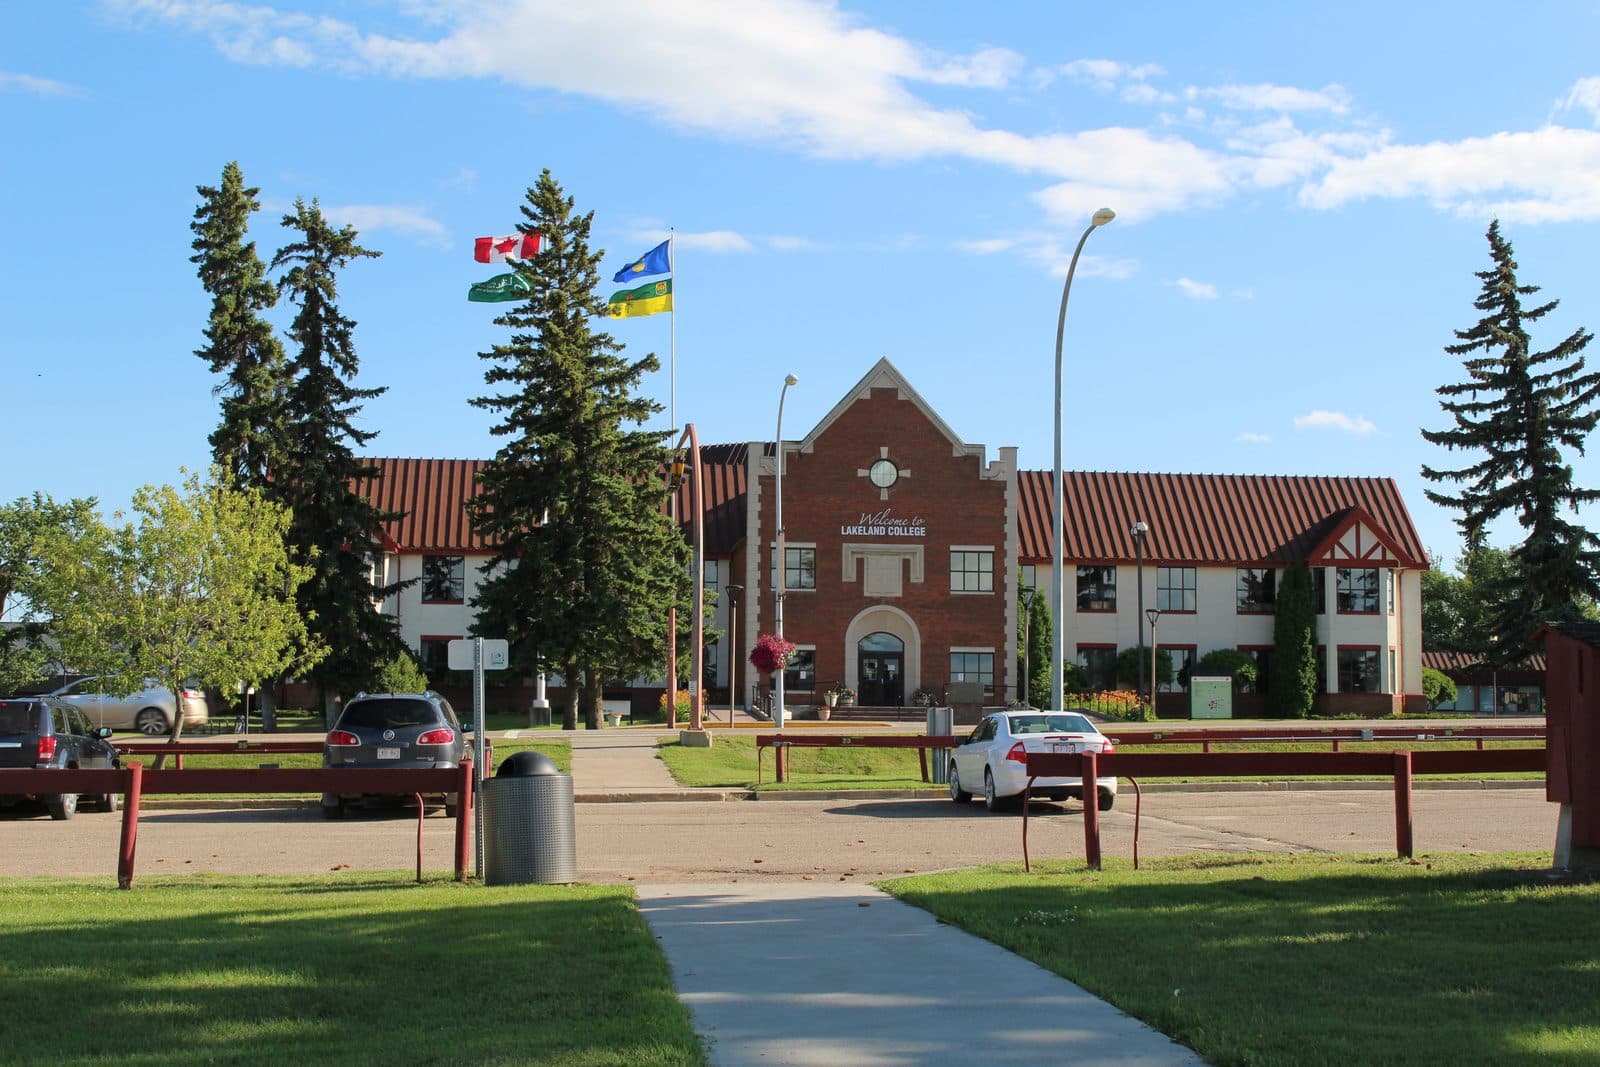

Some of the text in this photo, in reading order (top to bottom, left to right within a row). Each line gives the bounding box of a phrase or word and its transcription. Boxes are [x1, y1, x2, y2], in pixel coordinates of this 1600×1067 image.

[859, 508, 926, 526] Welcome to
[841, 525, 926, 537] LAKELAND COLLEGE
